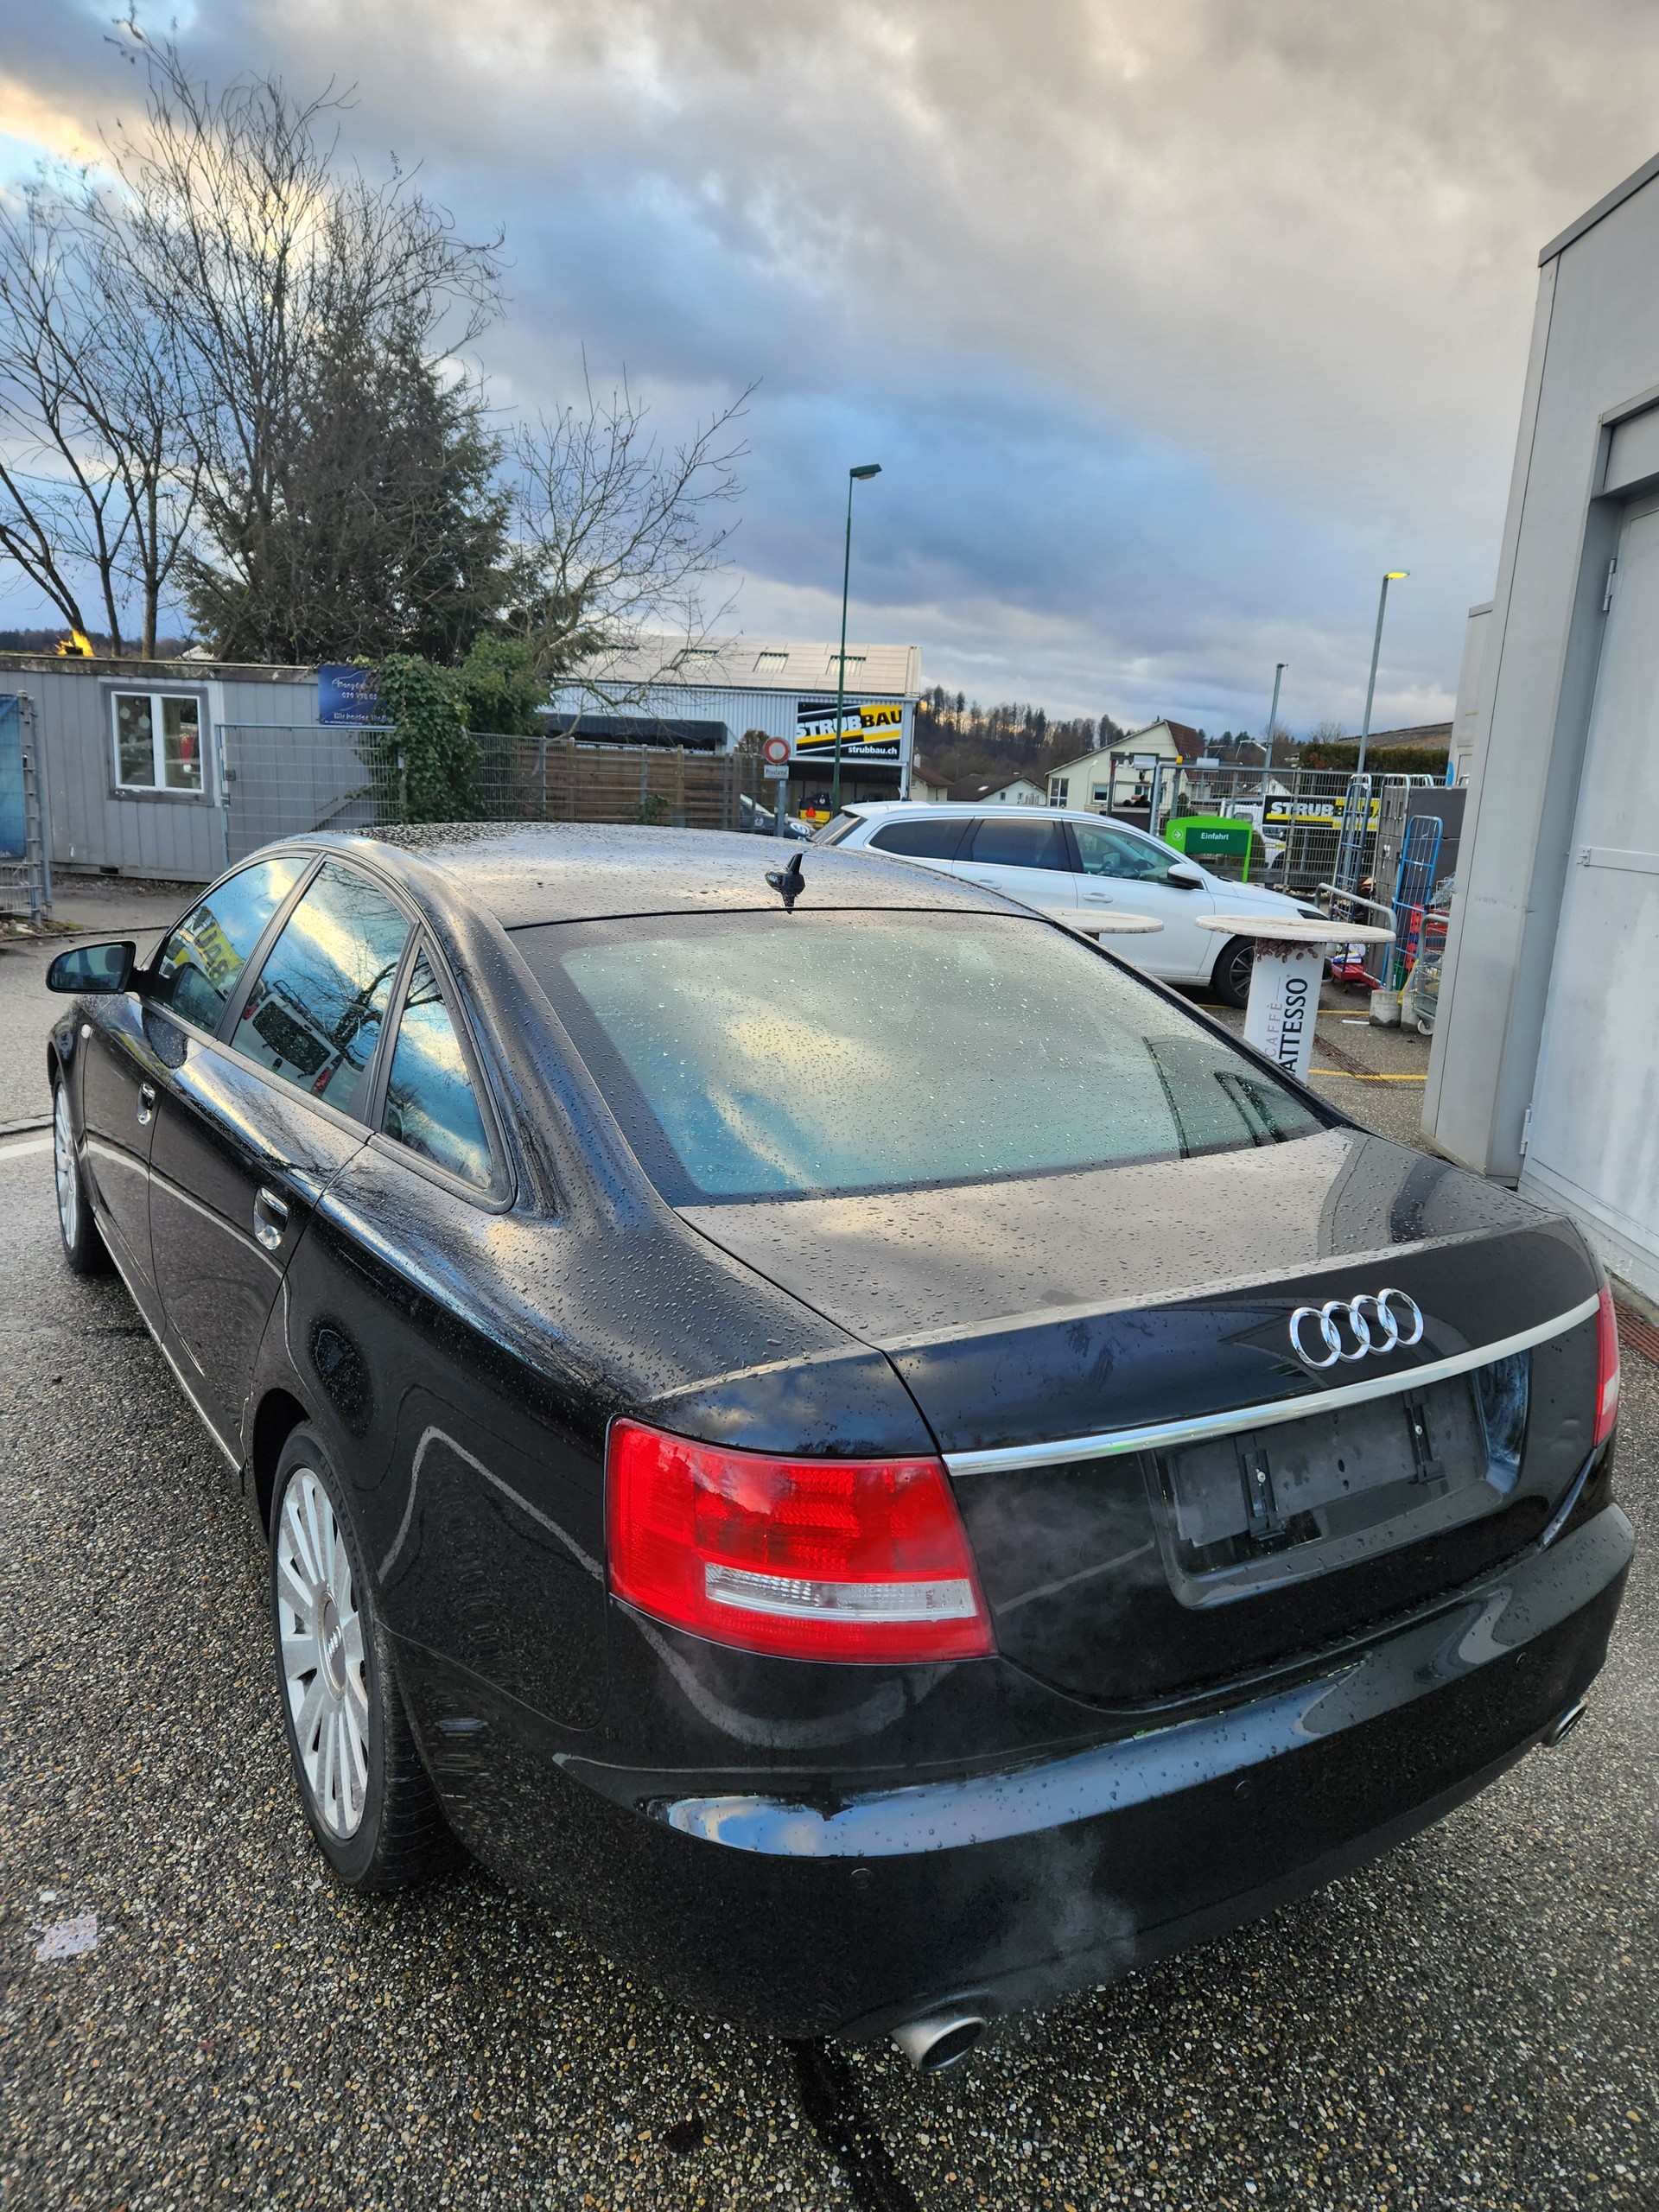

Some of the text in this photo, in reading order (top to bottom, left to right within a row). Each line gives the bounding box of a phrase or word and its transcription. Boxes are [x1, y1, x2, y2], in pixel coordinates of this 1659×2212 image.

[848, 745, 898, 755] strubbau.ch
[1264, 1002, 1283, 1058] CAFFÈ
[1279, 978, 1308, 1076] ATTESSO
